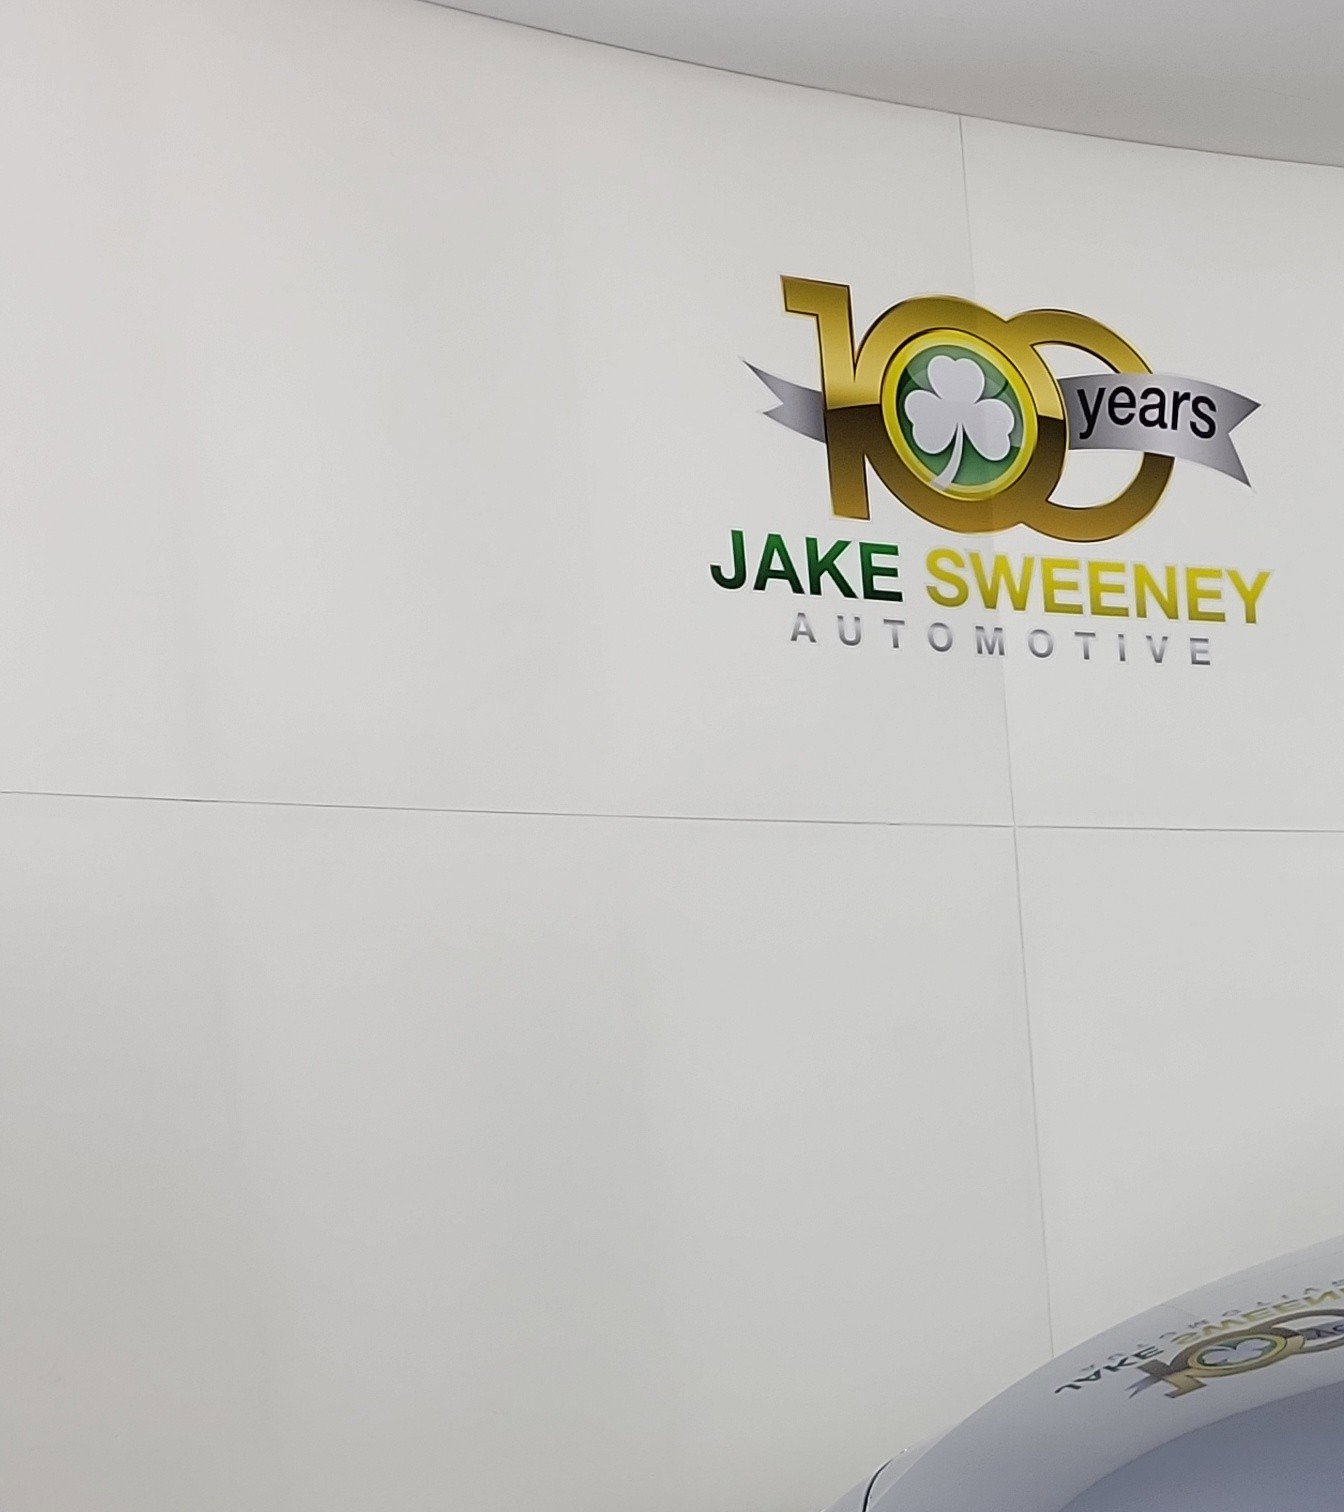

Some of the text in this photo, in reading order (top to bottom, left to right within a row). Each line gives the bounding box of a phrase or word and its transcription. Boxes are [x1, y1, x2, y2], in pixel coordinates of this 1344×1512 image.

[780, 274, 1218, 543] 100 years
[709, 529, 1273, 624] JAKE SWEENEY
[790, 612, 1212, 666] AUTOMOTIVE
